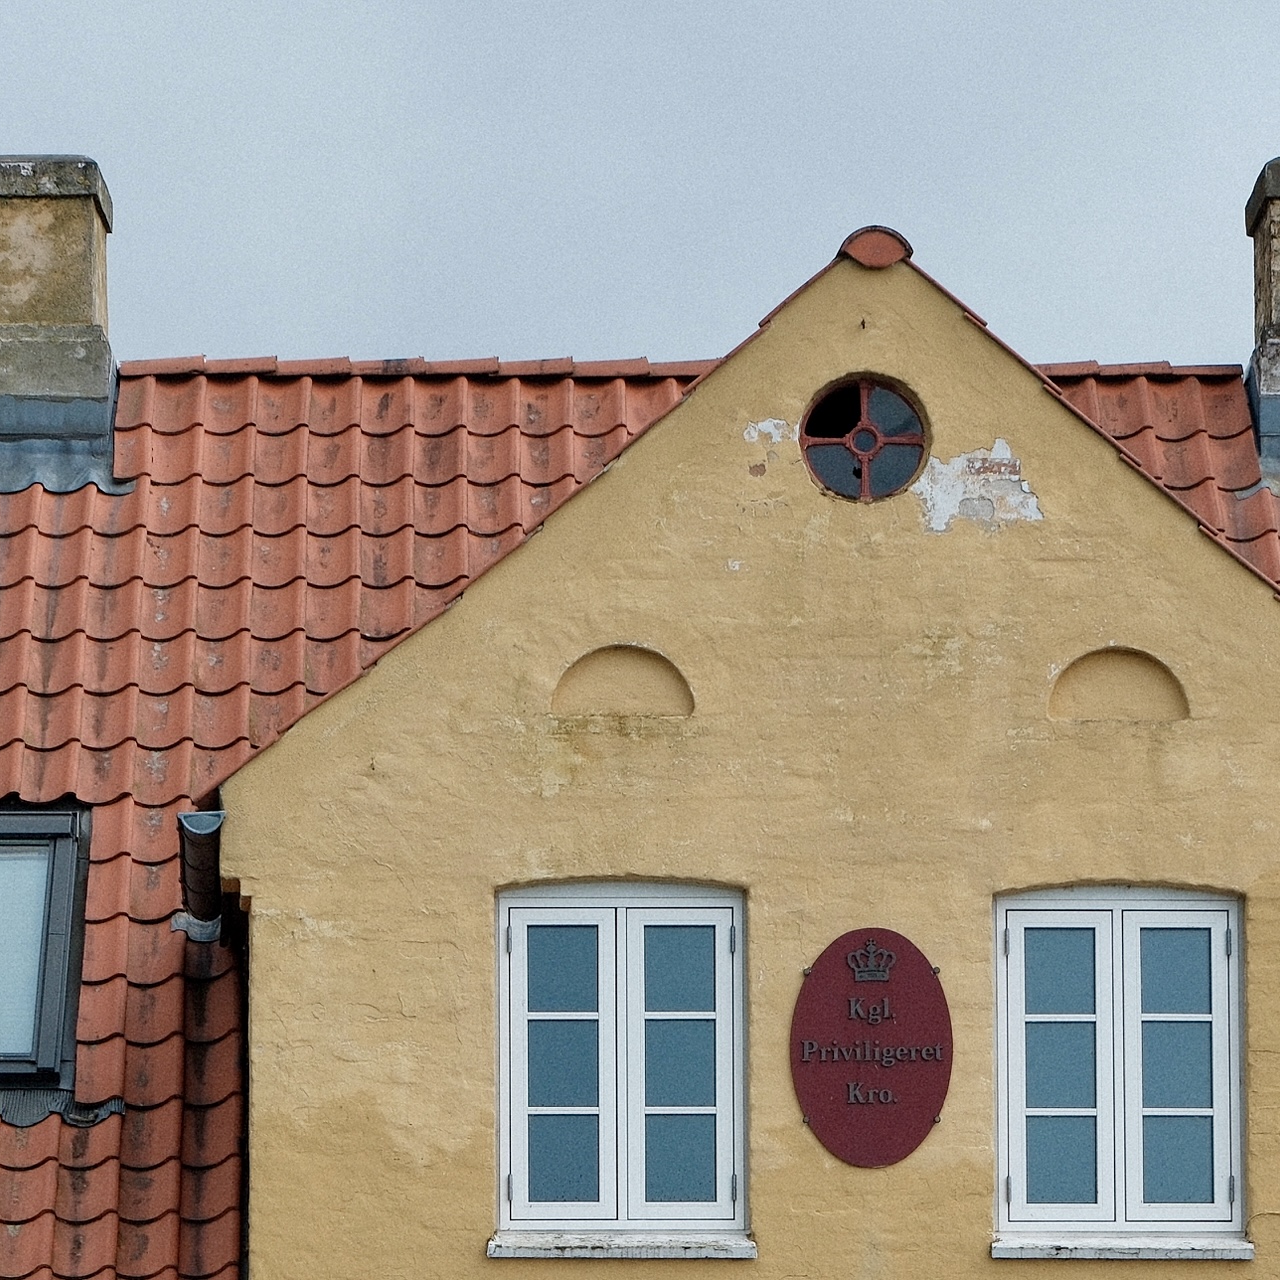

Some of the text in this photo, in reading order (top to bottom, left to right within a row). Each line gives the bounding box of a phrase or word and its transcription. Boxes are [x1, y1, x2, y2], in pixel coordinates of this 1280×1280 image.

[847, 997, 896, 1024] Kgl.
[801, 1040, 943, 1067] Priviligeret
[847, 1082, 897, 1105] Kro.
